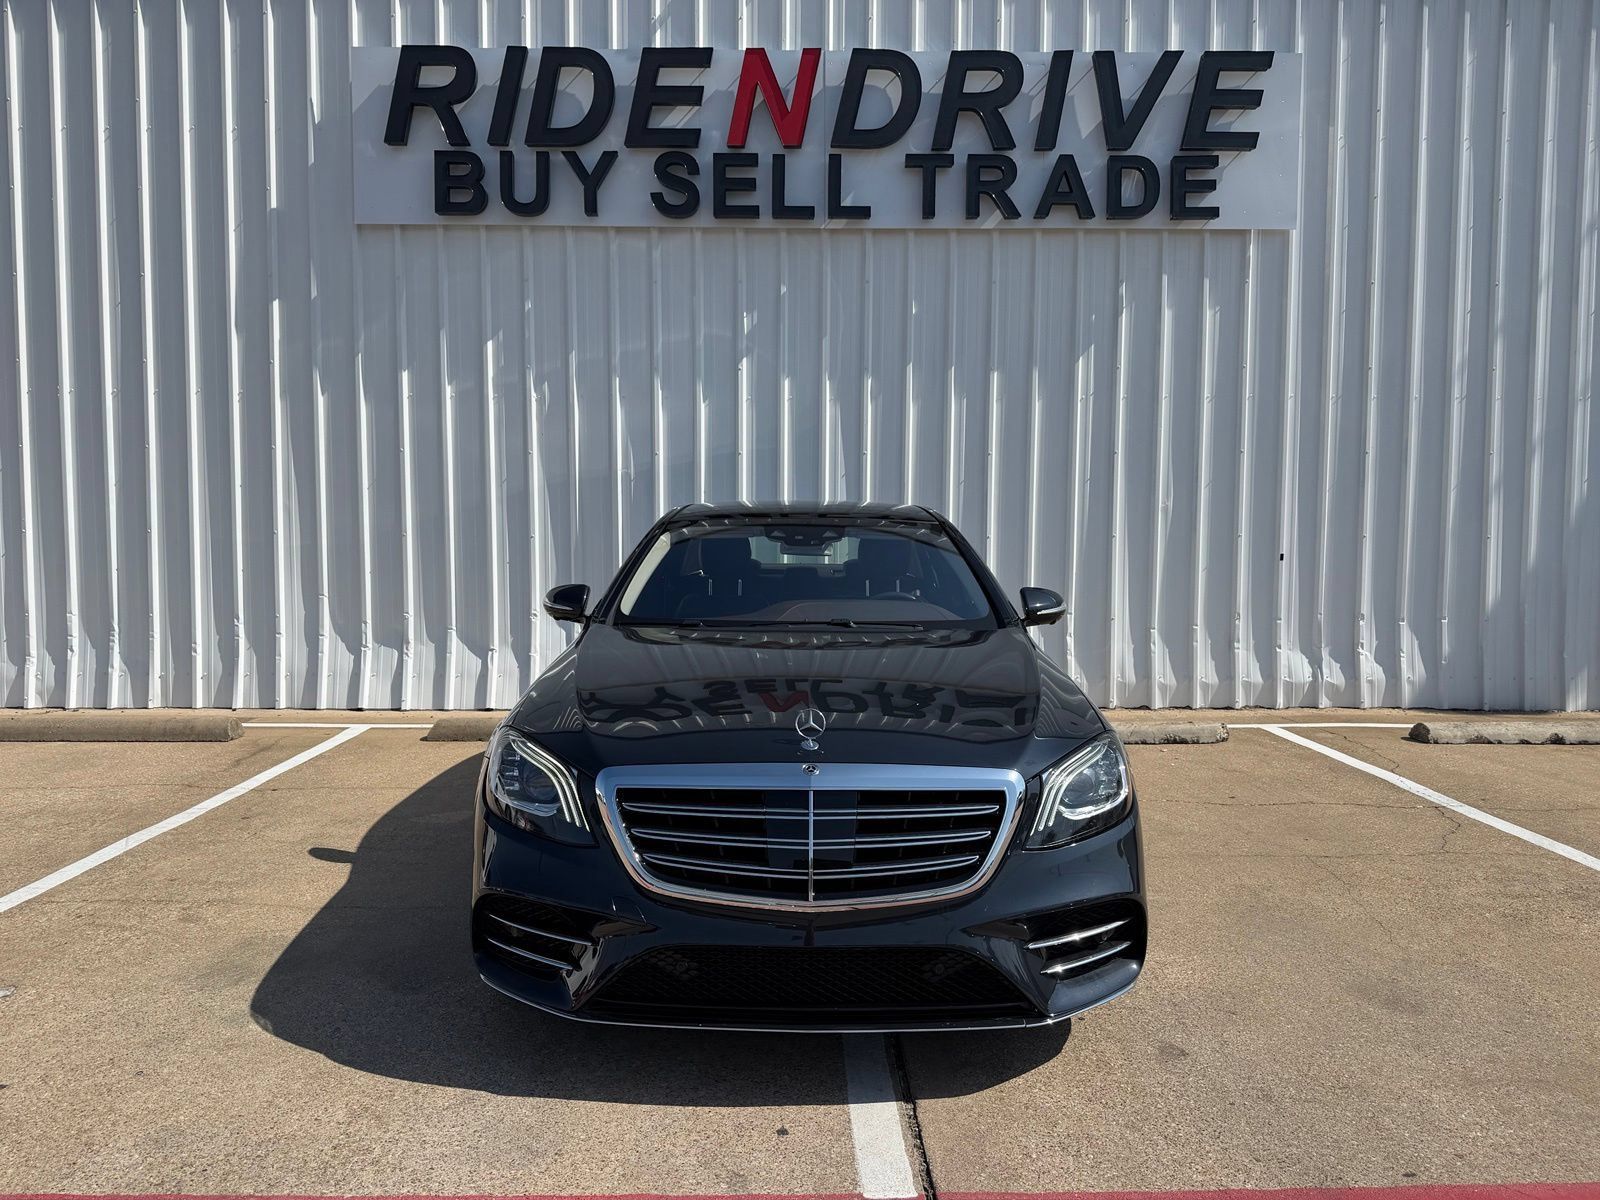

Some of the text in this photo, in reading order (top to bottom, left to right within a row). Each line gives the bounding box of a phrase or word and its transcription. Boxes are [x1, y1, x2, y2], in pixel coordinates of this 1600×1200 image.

[384, 45, 1275, 152] RIDENDRIVE
[434, 150, 1220, 221] BUY SELL TRADE
